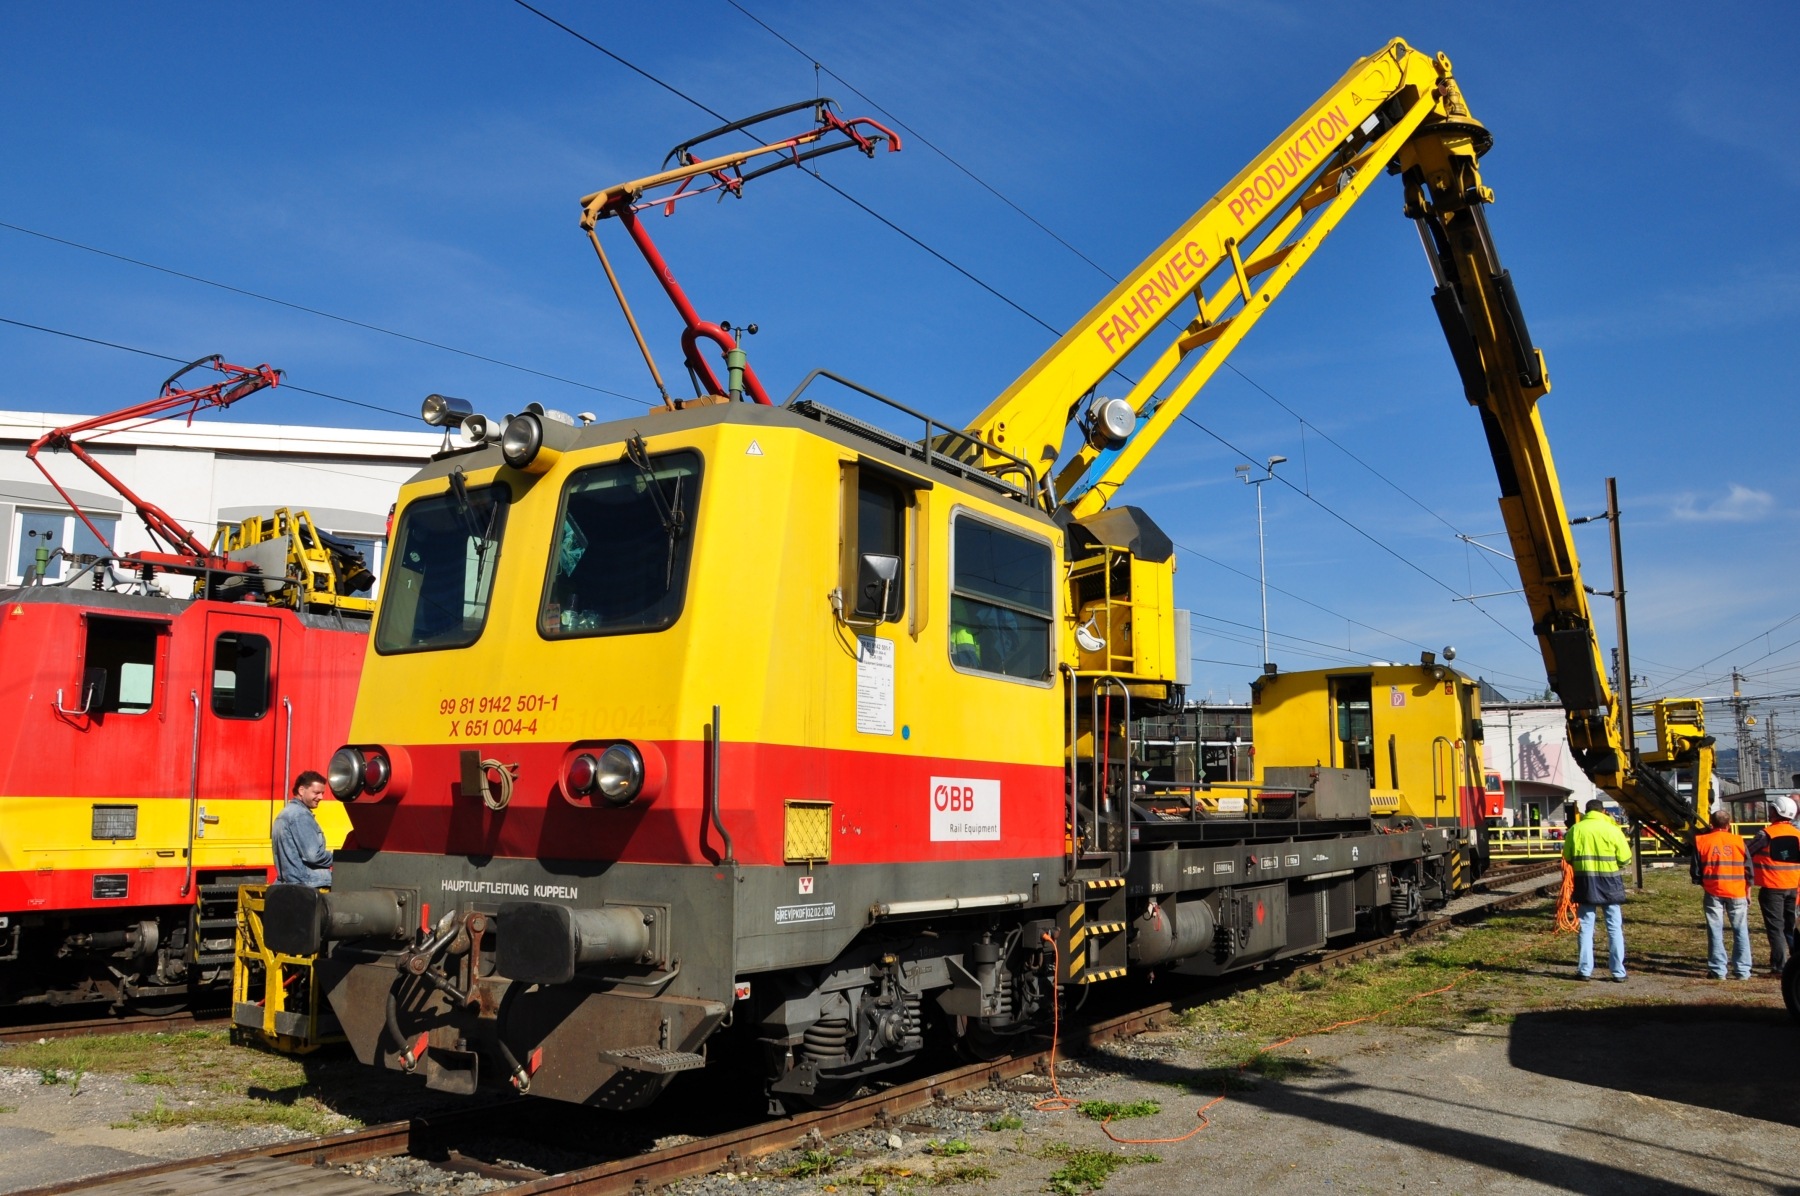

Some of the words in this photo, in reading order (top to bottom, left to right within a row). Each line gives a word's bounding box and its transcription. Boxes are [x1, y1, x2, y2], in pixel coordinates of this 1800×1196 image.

[1096, 241, 1209, 354] FAHRWEG
[1227, 104, 1350, 226] PRODUKTION
[439, 699, 456, 715] 99
[459, 697, 475, 714] 81
[478, 696, 511, 713] 9142
[516, 694, 559, 712] 501-1
[449, 720, 460, 737] X
[465, 719, 489, 736] 651
[493, 718, 538, 736] 004-4
[934, 784, 974, 812] ÖBB
[949, 823, 962, 833] Rail
[964, 823, 997, 835] Equipment
[441, 880, 529, 896] HAUPTLUFTLEITUNG
[533, 885, 578, 899] KUPPELN
